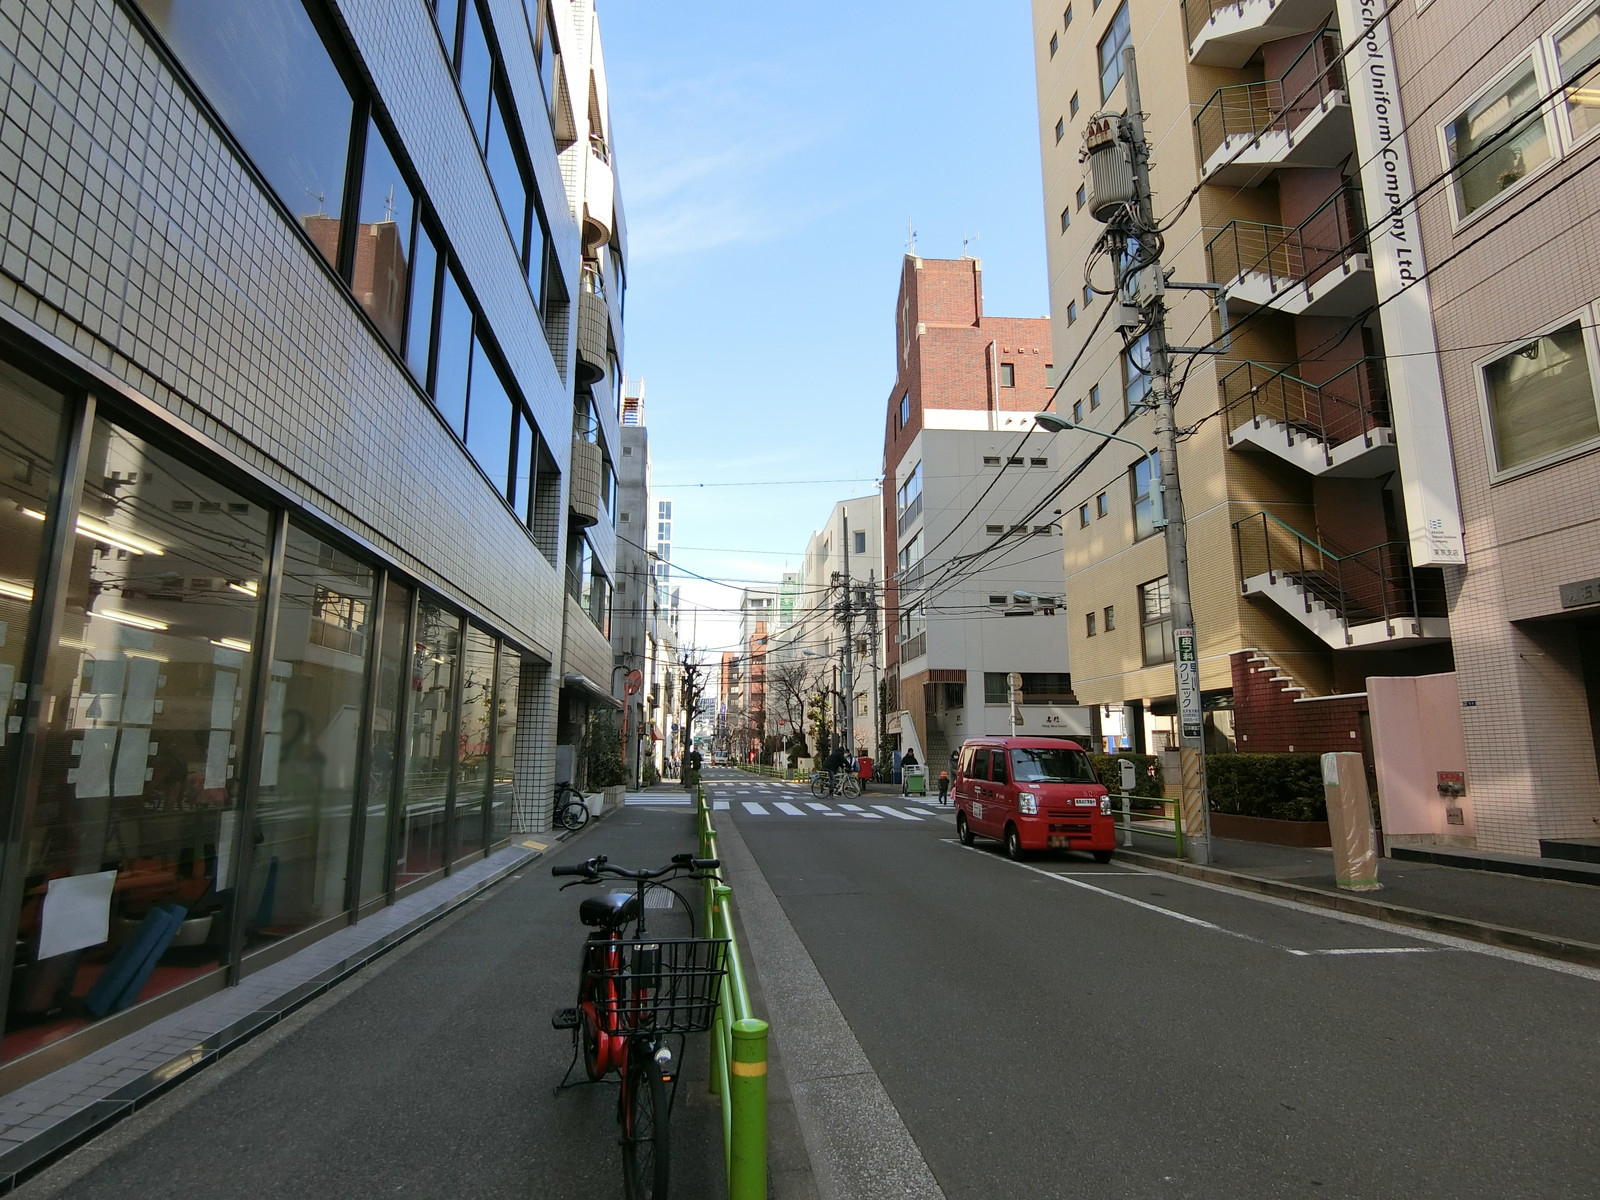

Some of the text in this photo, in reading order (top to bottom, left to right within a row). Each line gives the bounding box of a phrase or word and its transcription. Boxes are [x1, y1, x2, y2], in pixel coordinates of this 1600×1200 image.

[1360, 0, 1417, 287] School Uniform Company Ltd.
[1182, 637, 1193, 660] 皮フ科
[1180, 663, 1191, 708] クリニック
